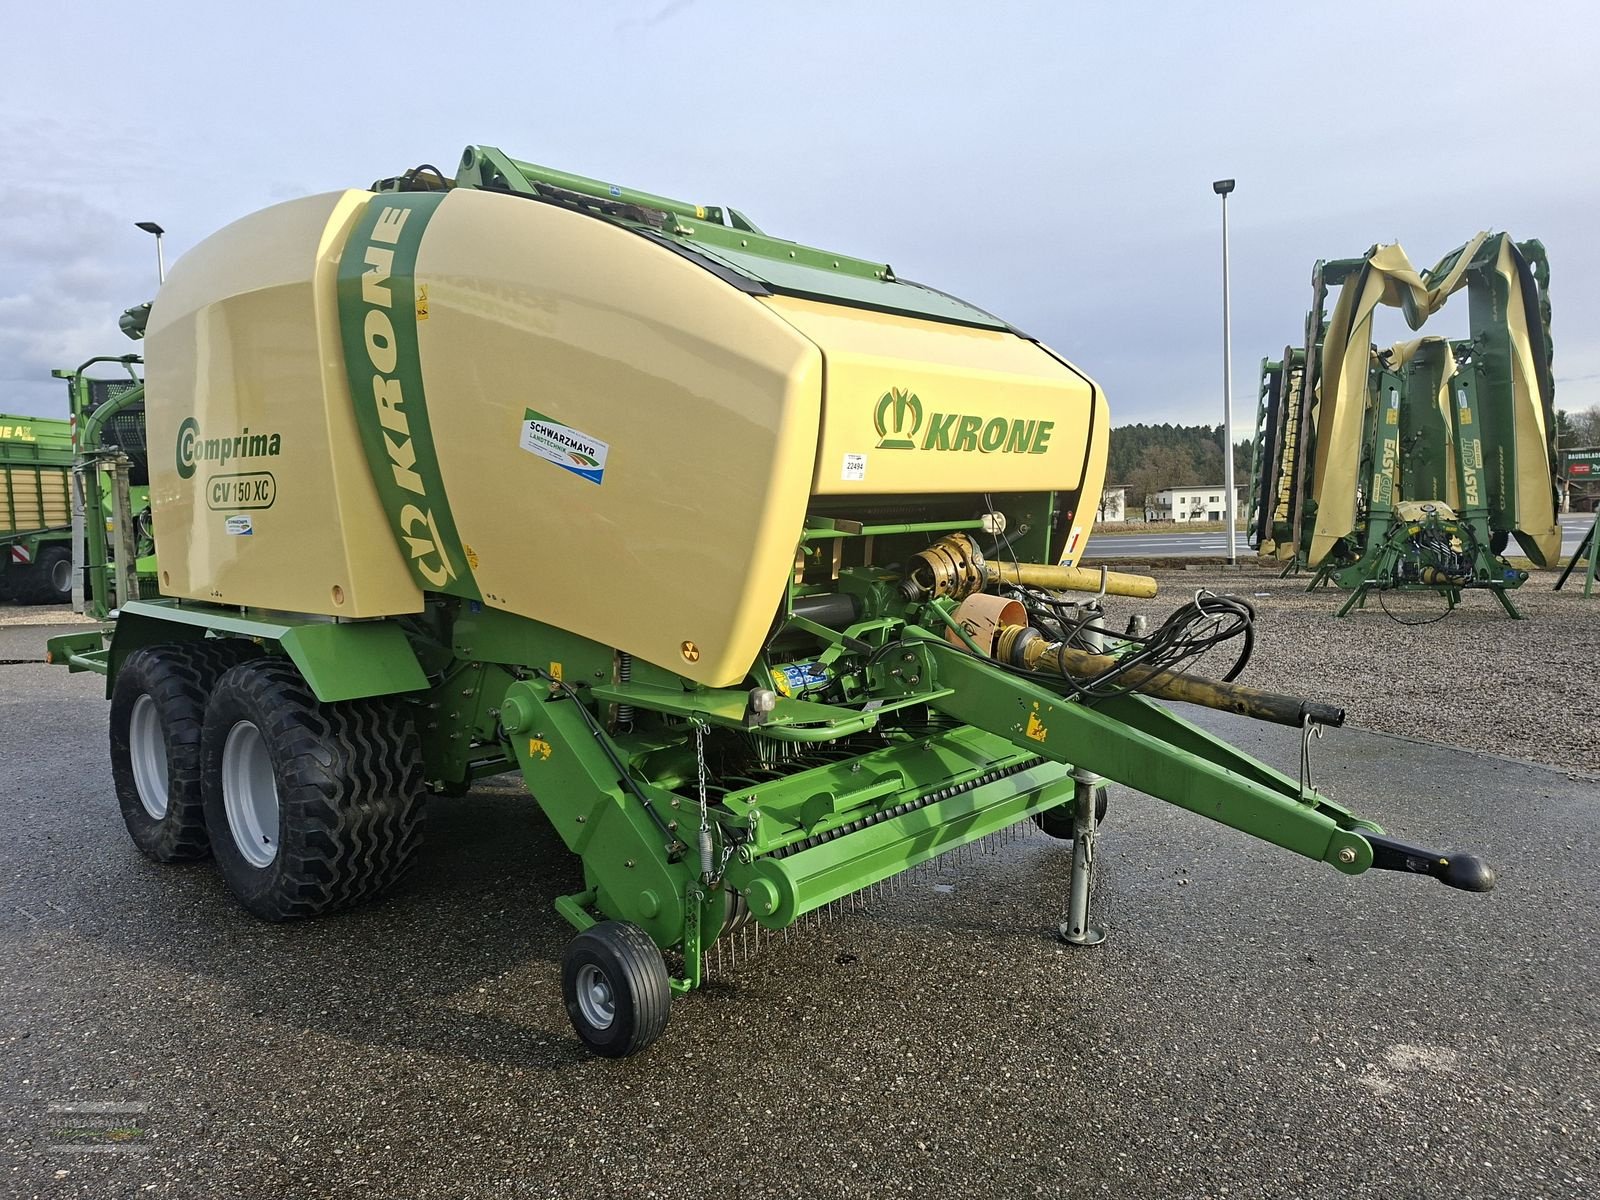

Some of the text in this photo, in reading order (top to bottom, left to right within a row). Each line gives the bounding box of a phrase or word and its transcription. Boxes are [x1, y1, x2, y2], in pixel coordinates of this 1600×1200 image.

[362, 207, 426, 496] KRONE
[176, 417, 281, 479] Comprima
[529, 421, 595, 457] SCHWARZMAYR
[529, 433, 567, 453] LANDTECHNIK
[921, 412, 1055, 454] KRONE
[847, 462, 863, 470] 22494
[213, 480, 269, 503] CV 150 XC
